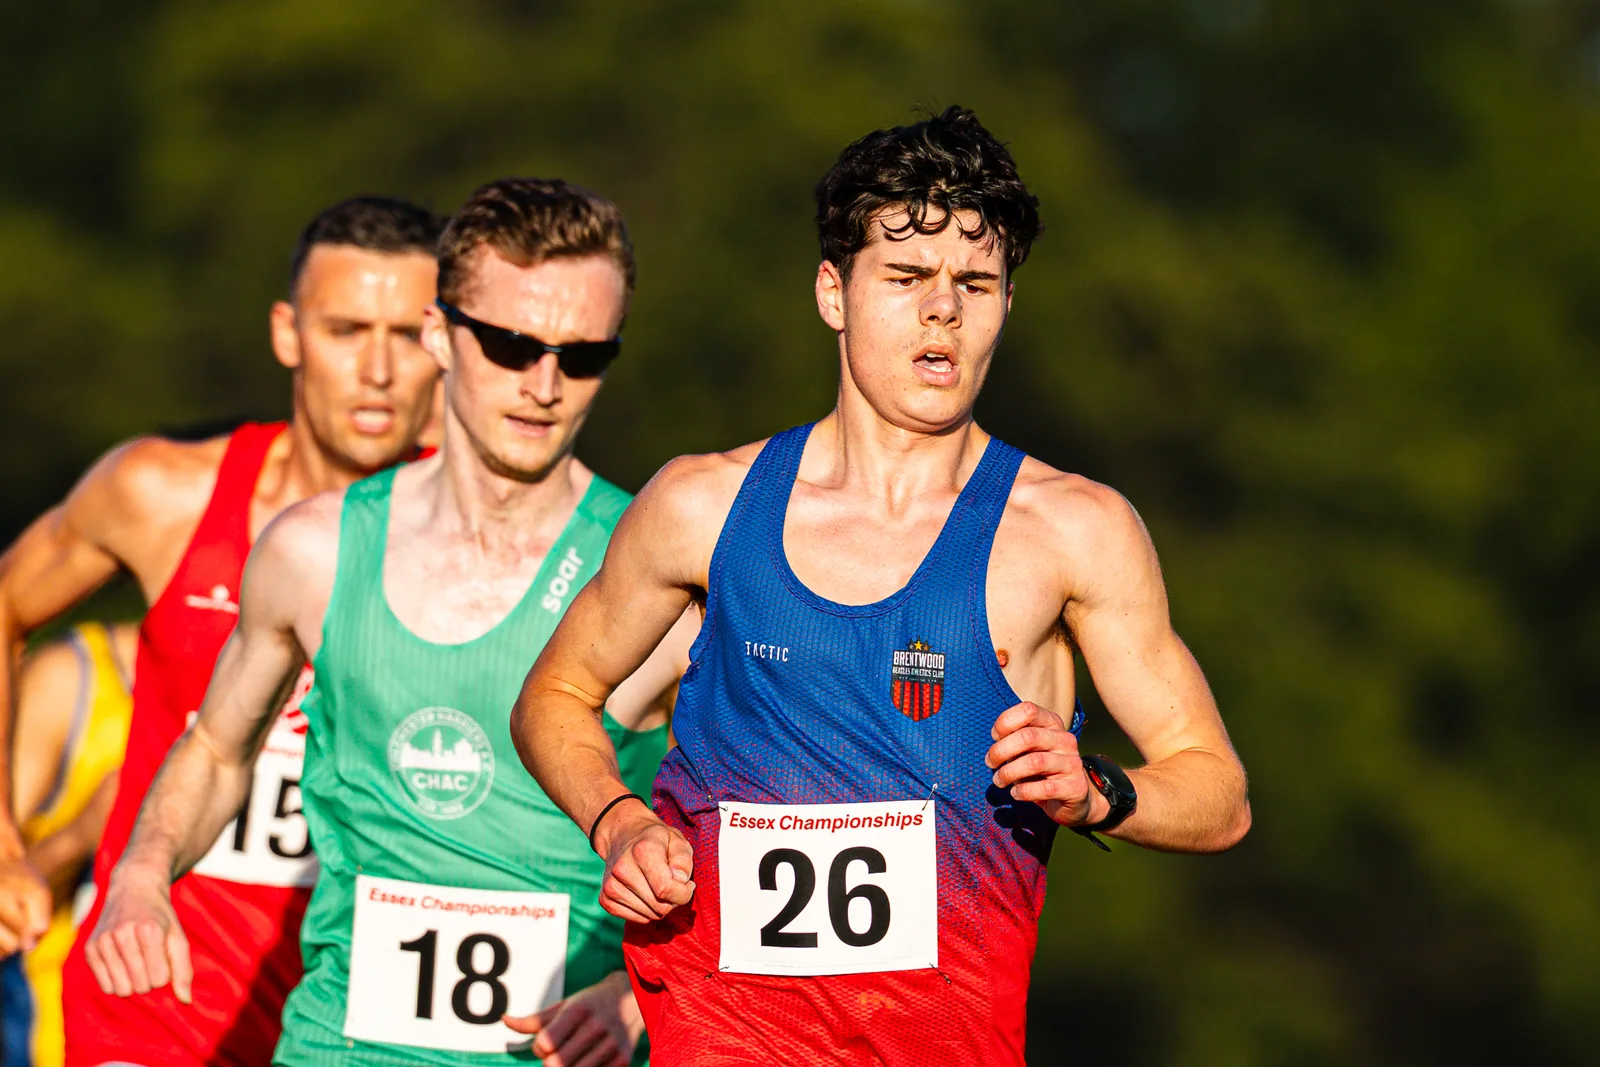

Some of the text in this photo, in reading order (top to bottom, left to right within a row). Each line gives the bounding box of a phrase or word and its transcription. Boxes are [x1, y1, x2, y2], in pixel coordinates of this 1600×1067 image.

[541, 546, 584, 614] soar
[745, 641, 789, 662] TACTIC
[893, 650, 945, 669] BRENTWOOD
[932, 670, 944, 679] CLUB
[411, 771, 469, 791] CHAC
[233, 776, 314, 859] 15
[729, 812, 924, 833] Essex Championships
[369, 887, 556, 920] Essex Championships
[758, 846, 891, 948] 26
[399, 929, 511, 1025] 18
